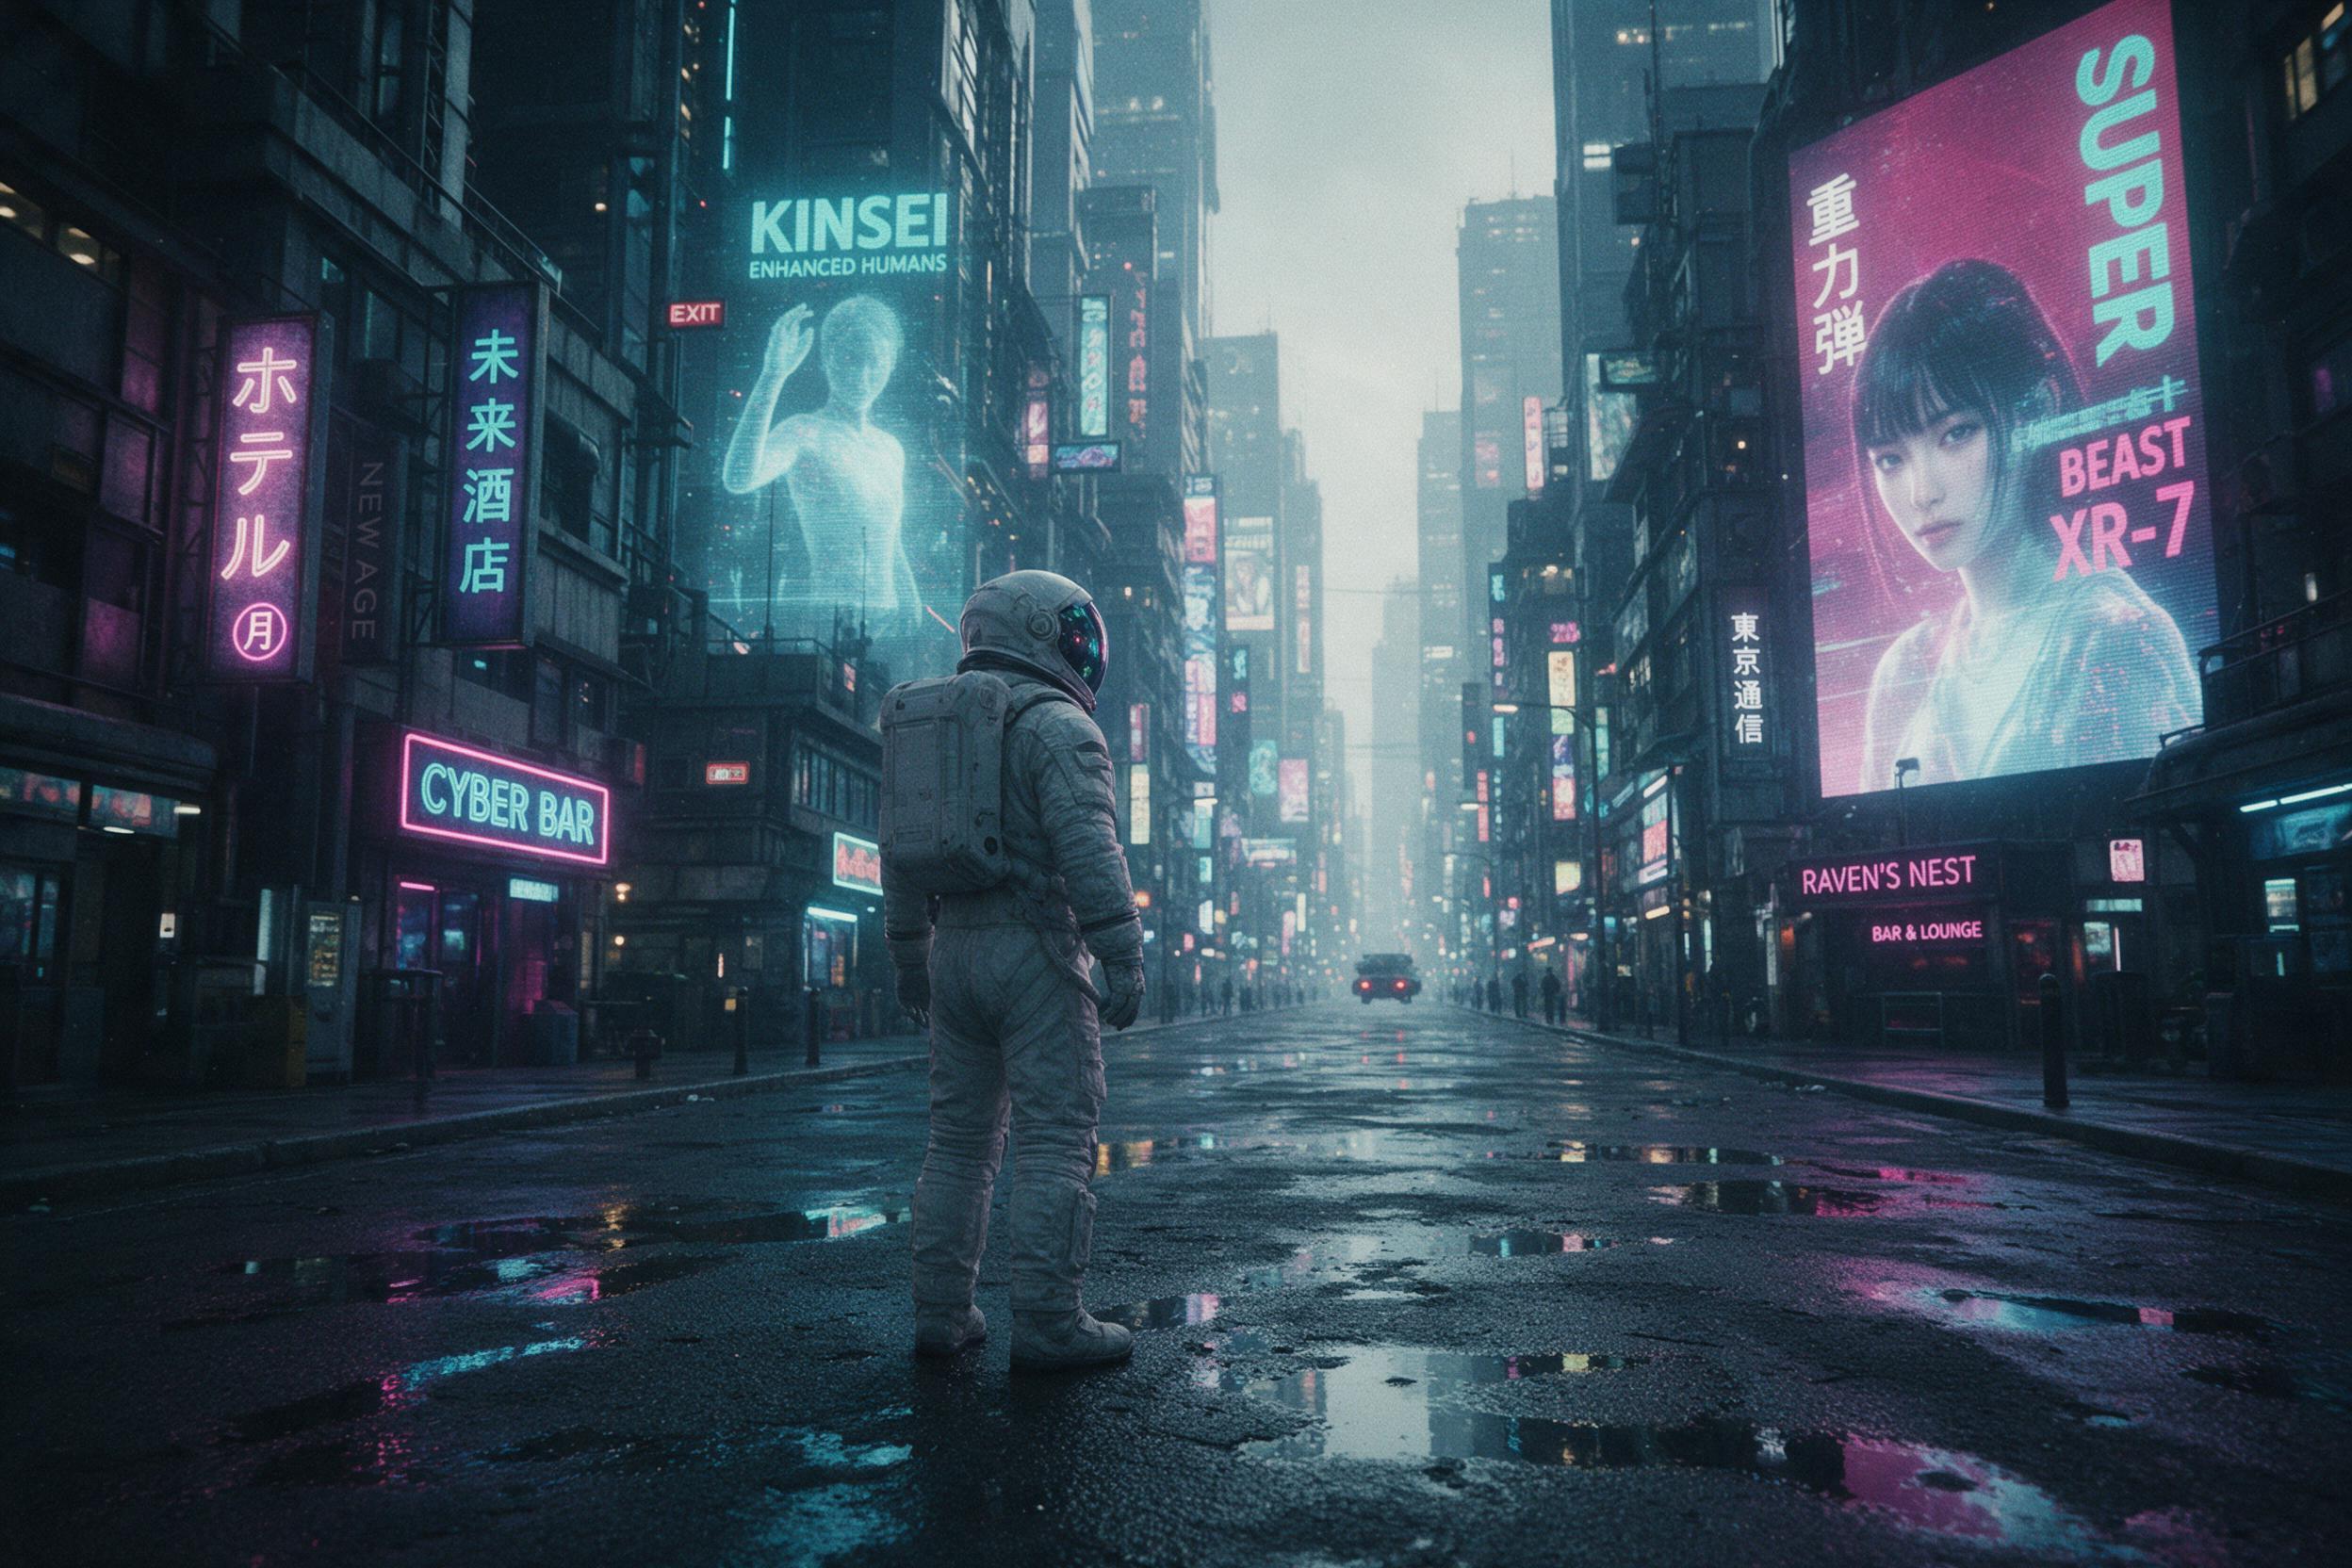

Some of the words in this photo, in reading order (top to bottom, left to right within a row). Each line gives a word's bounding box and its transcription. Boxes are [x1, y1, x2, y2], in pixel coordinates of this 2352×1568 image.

[751, 193, 948, 253] KINSEI
[2075, 34, 2175, 368] SUPER
[749, 257, 856, 279] ENHANCED
[860, 253, 947, 274] HUMANS
[1806, 173, 1869, 375] 重力弾
[670, 303, 721, 322] EXIT
[220, 347, 298, 580] ホテル
[459, 329, 519, 594] 未来酒店
[2059, 416, 2191, 498] BEAST
[356, 462, 384, 548] NEW
[2050, 480, 2195, 582] XR-7
[351, 559, 379, 640] AGE
[1730, 612, 1764, 743] 東京通信
[420, 762, 529, 831] CYBER
[538, 791, 594, 845] BAR
[1802, 861, 1902, 894] RAVEN'S
[1908, 855, 1977, 888] NEST
[1871, 924, 1902, 942] BAR
[1904, 923, 1918, 941] &
[1920, 921, 1984, 939] LOUNGE
